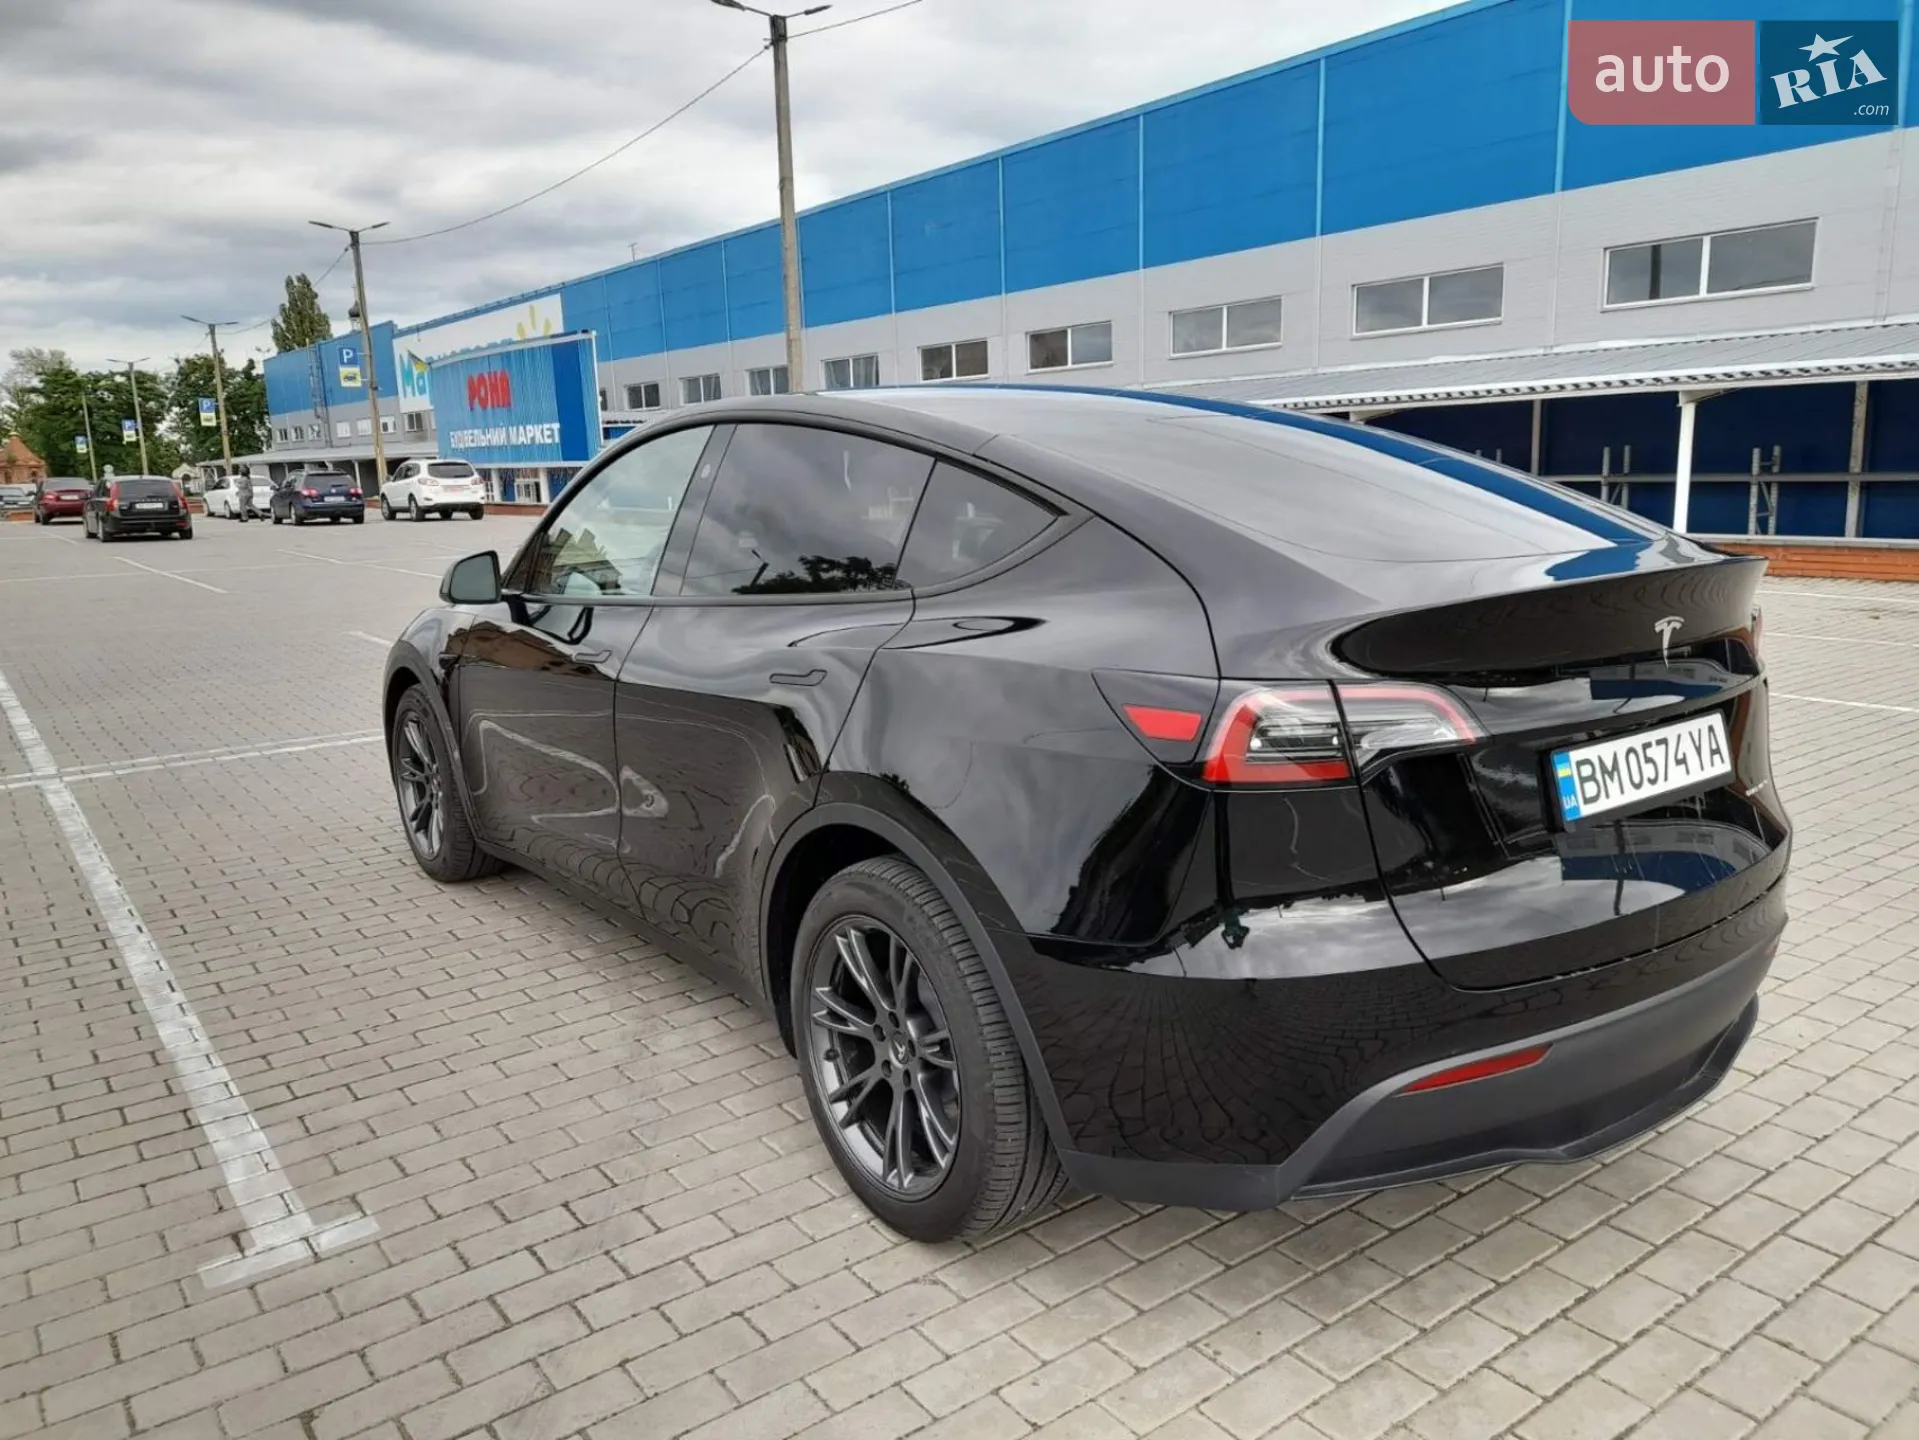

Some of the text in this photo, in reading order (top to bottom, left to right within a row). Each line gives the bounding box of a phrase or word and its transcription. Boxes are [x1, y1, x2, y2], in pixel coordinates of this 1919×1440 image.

[343, 349, 354, 364] P
[508, 422, 561, 446] МАРКЕТ
[1564, 795, 1578, 809] UA
